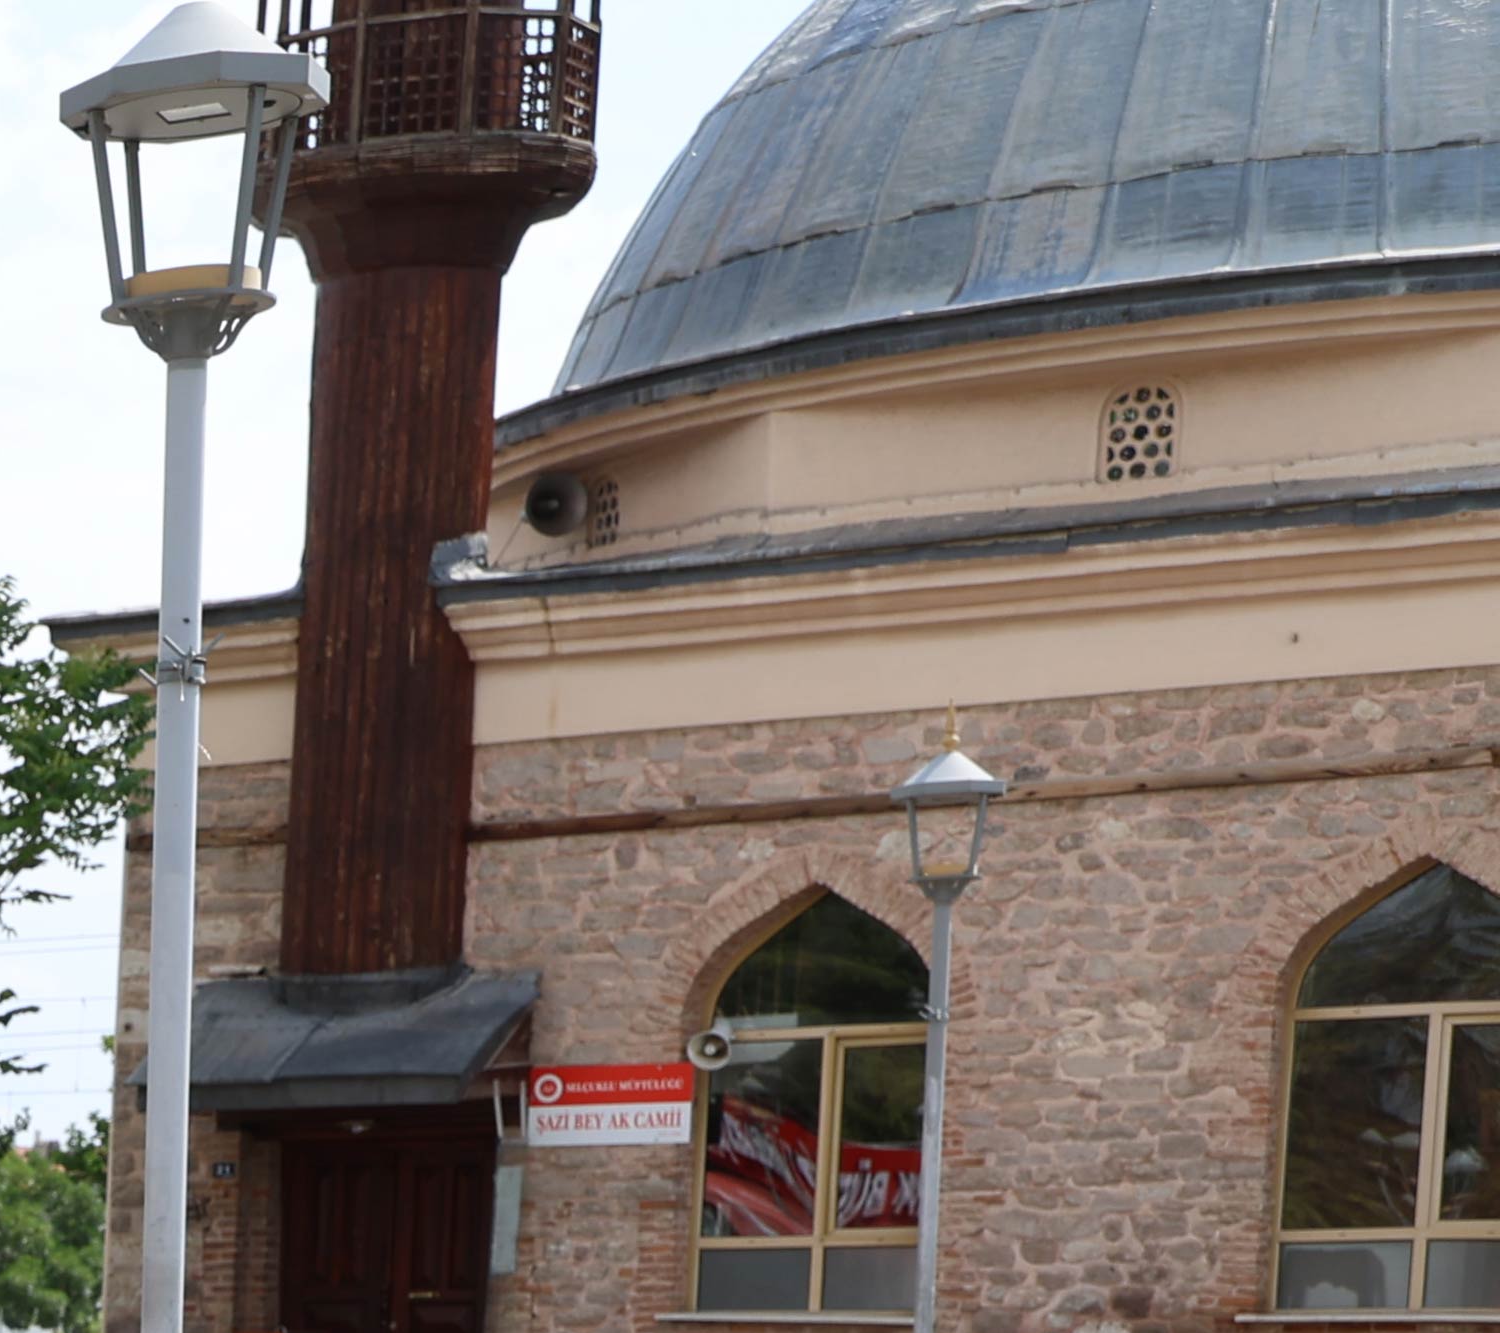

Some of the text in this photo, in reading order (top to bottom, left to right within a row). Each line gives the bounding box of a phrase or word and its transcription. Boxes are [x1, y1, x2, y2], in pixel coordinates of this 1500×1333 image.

[574, 1112, 604, 1131] BEY
[608, 1112, 630, 1130] AK
[633, 1108, 682, 1129] CAMİİ
